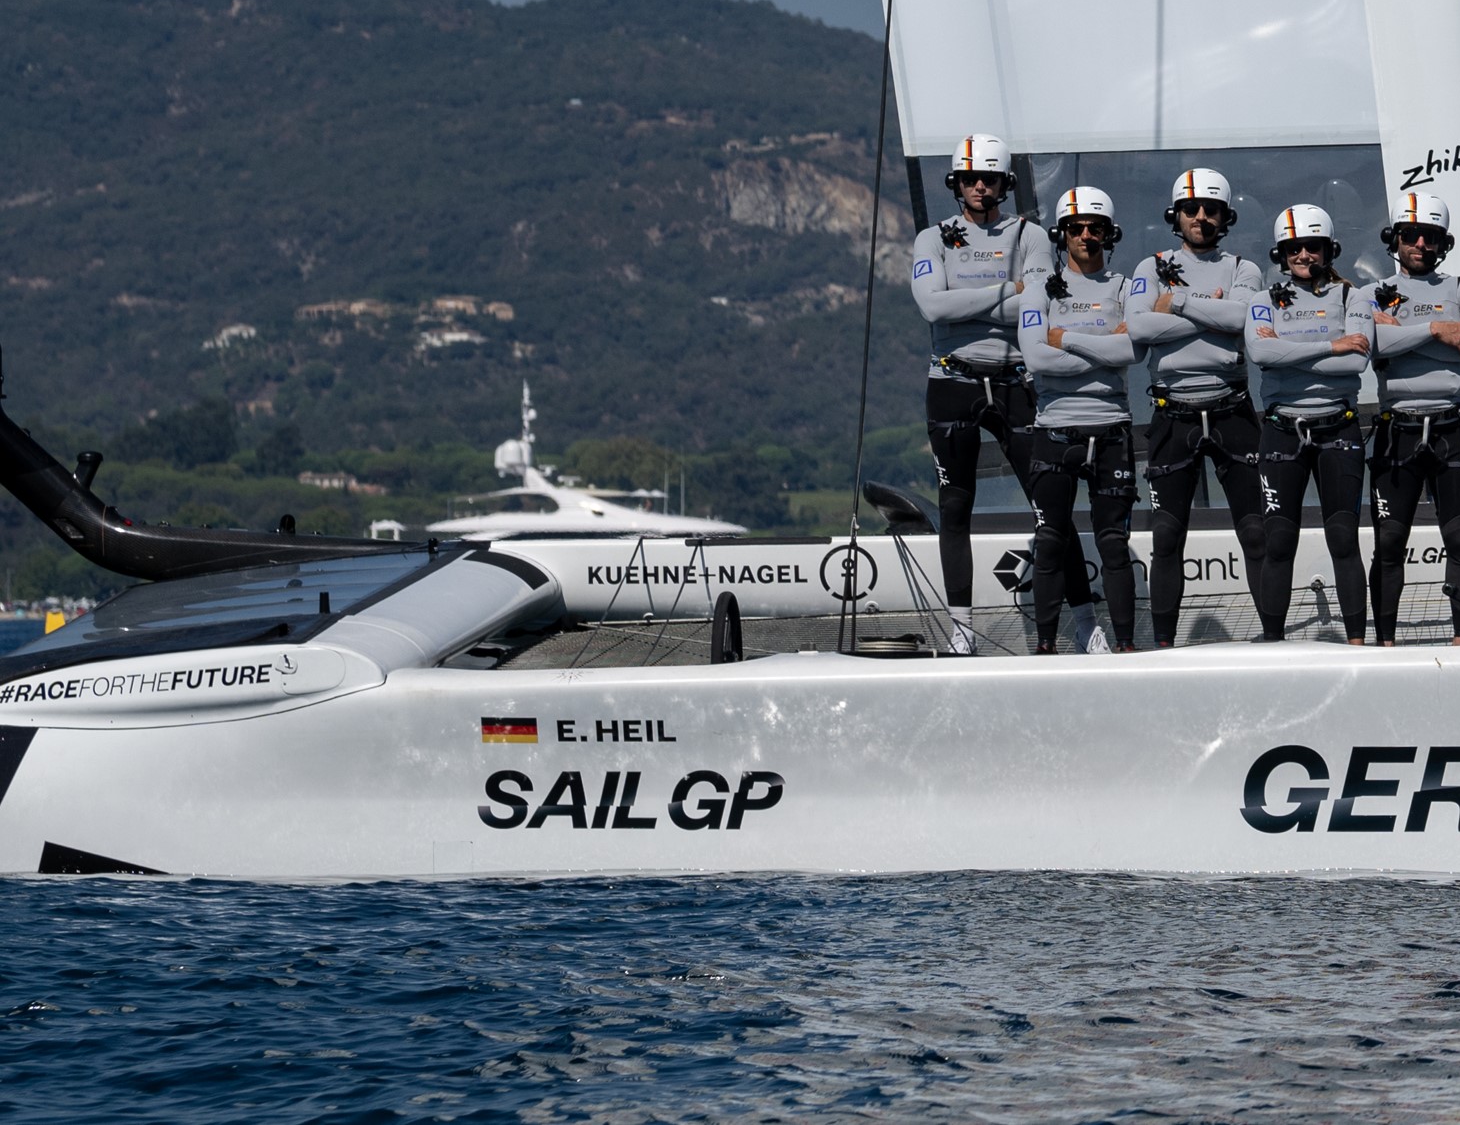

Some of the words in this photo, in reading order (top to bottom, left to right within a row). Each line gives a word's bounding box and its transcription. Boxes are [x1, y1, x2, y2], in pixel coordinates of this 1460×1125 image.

[1072, 302, 1091, 310] GER
[1413, 304, 1433, 312] GER
[1259, 473, 1281, 515] zhik
[588, 565, 808, 585] KUEHNE+NAGEL
[0, 663, 273, 704] #RACEFORTHEFUTURE
[596, 719, 677, 742] HEIL
